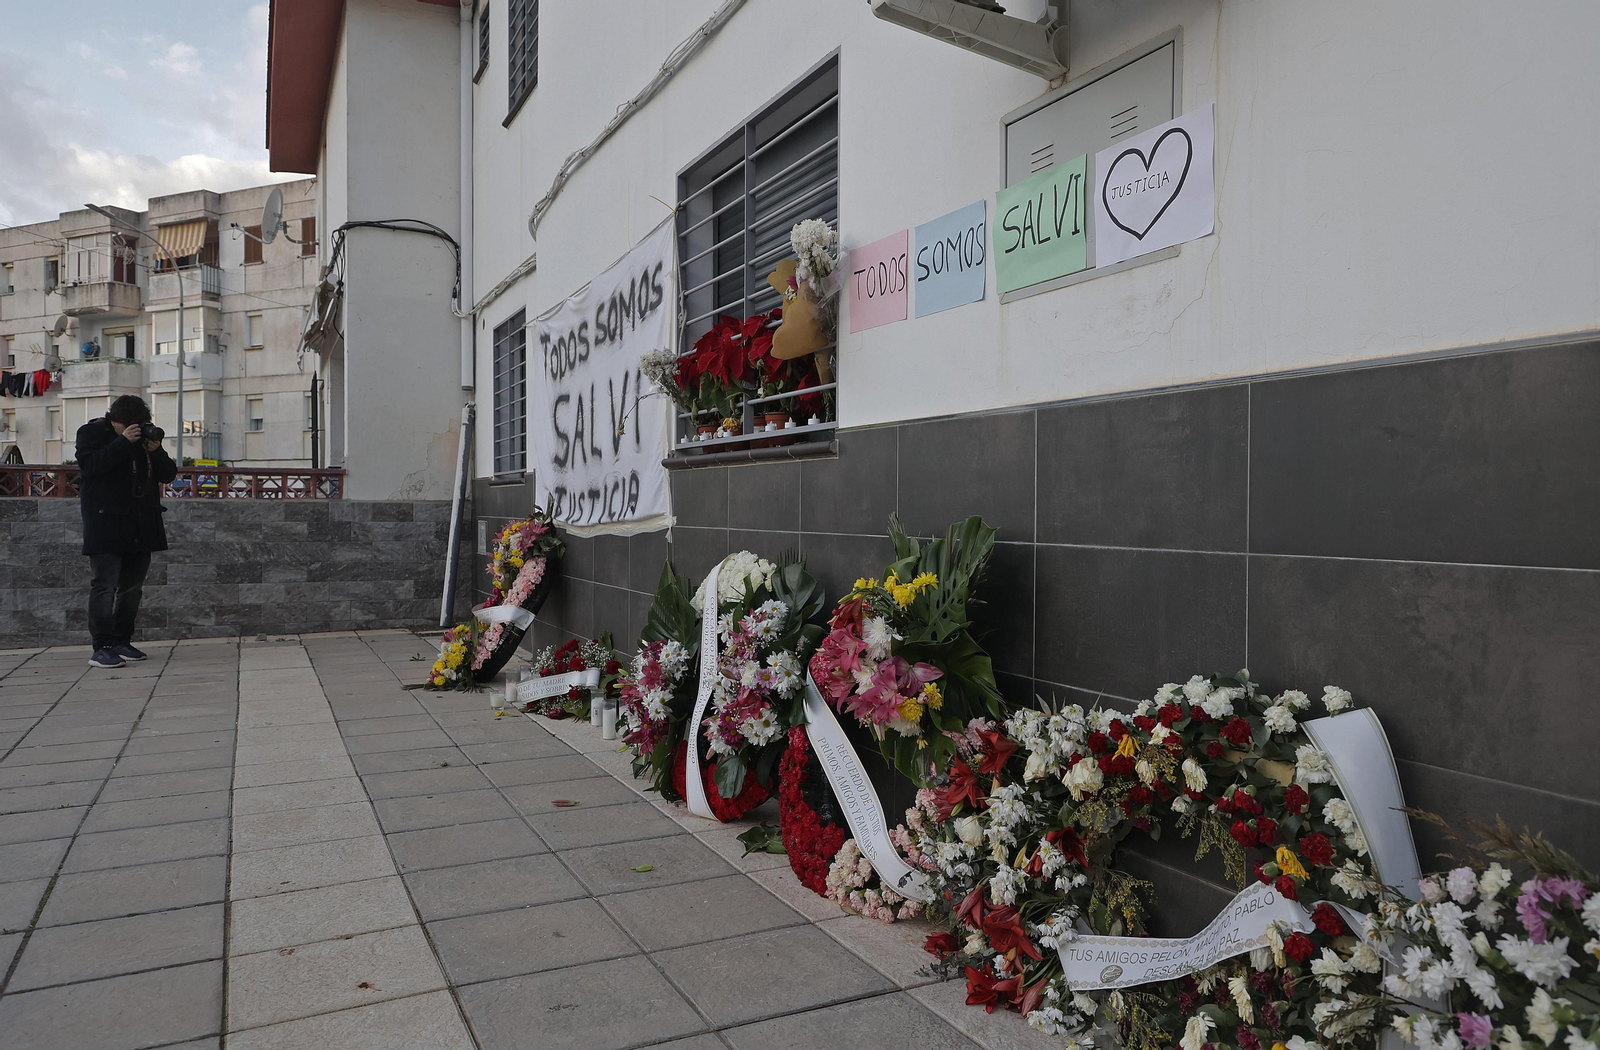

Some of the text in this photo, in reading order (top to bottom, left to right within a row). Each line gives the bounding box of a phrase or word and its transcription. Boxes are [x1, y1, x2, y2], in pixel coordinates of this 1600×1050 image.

[1002, 172, 1082, 254] SALVI
[1110, 170, 1171, 200] JUSTICIA
[853, 252, 906, 301] TODOS
[916, 222, 985, 282] SOMOS
[540, 262, 664, 384] TODOS SOMOS
[552, 367, 642, 470] SALVI
[553, 468, 640, 524] JUSTICIA
[523, 684, 533, 692] DE
[533, 682, 540, 690] TU
[543, 677, 566, 686] MADRE
[546, 684, 570, 694] SOBRIN
[817, 737, 841, 775] PRIMOS,
[835, 774, 858, 809] AMIGOS
[854, 815, 878, 861] FAMILIARES
[835, 743, 865, 793] RECUERDO
[860, 792, 872, 806] DE
[866, 804, 878, 822] TUS
[1070, 949, 1093, 961] TUS
[1095, 950, 1148, 964] AMIGOS
[1150, 946, 1190, 963] PELÓN,
[1235, 891, 1275, 921] PABLO
[1206, 942, 1218, 960] EN
[1219, 928, 1244, 950] PAZ.
